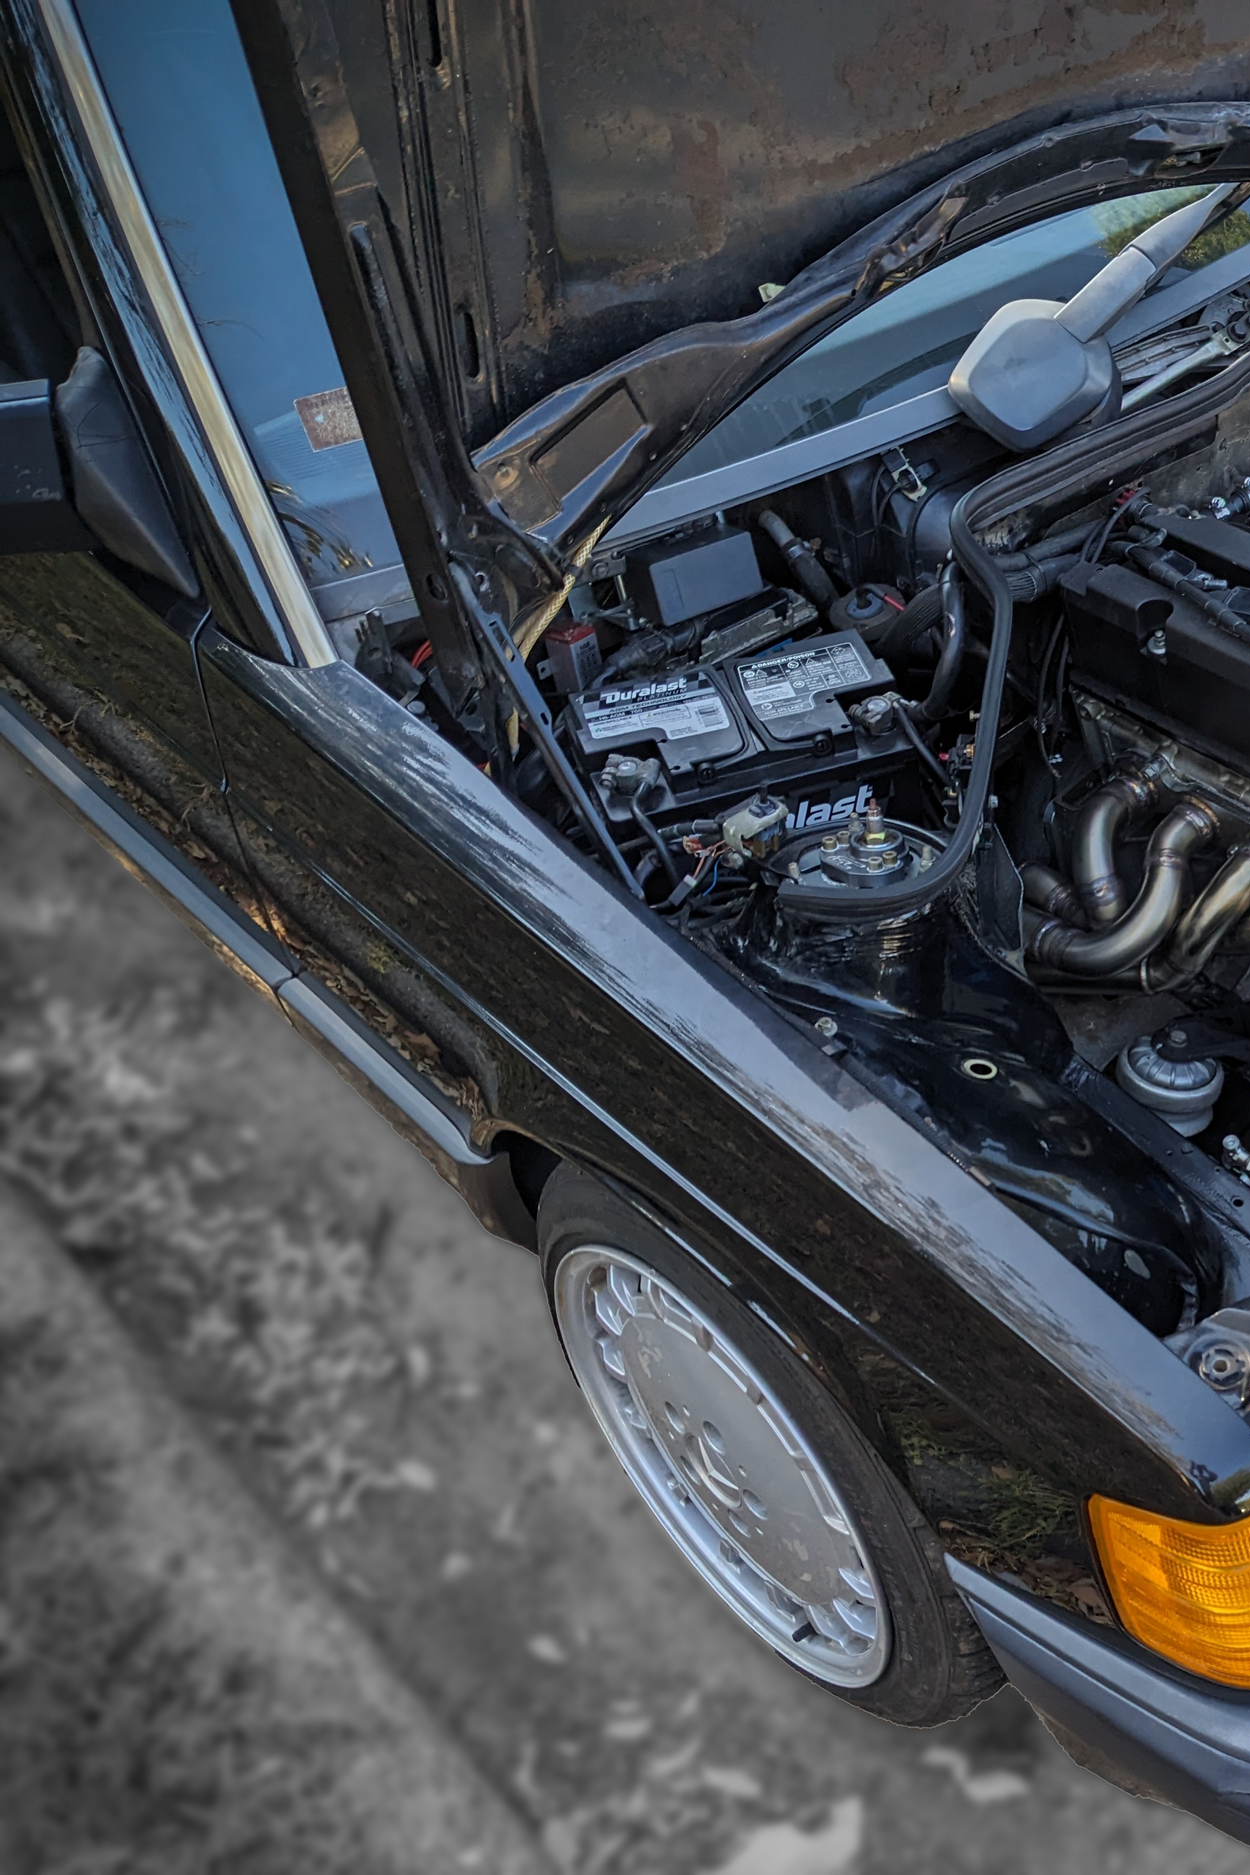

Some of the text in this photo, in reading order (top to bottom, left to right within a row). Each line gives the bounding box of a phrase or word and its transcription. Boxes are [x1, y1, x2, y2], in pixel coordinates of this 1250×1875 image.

[600, 678, 687, 704] Duralast
[637, 688, 687, 702] PLATINUM
[631, 694, 687, 708] TECHNOLOGY
